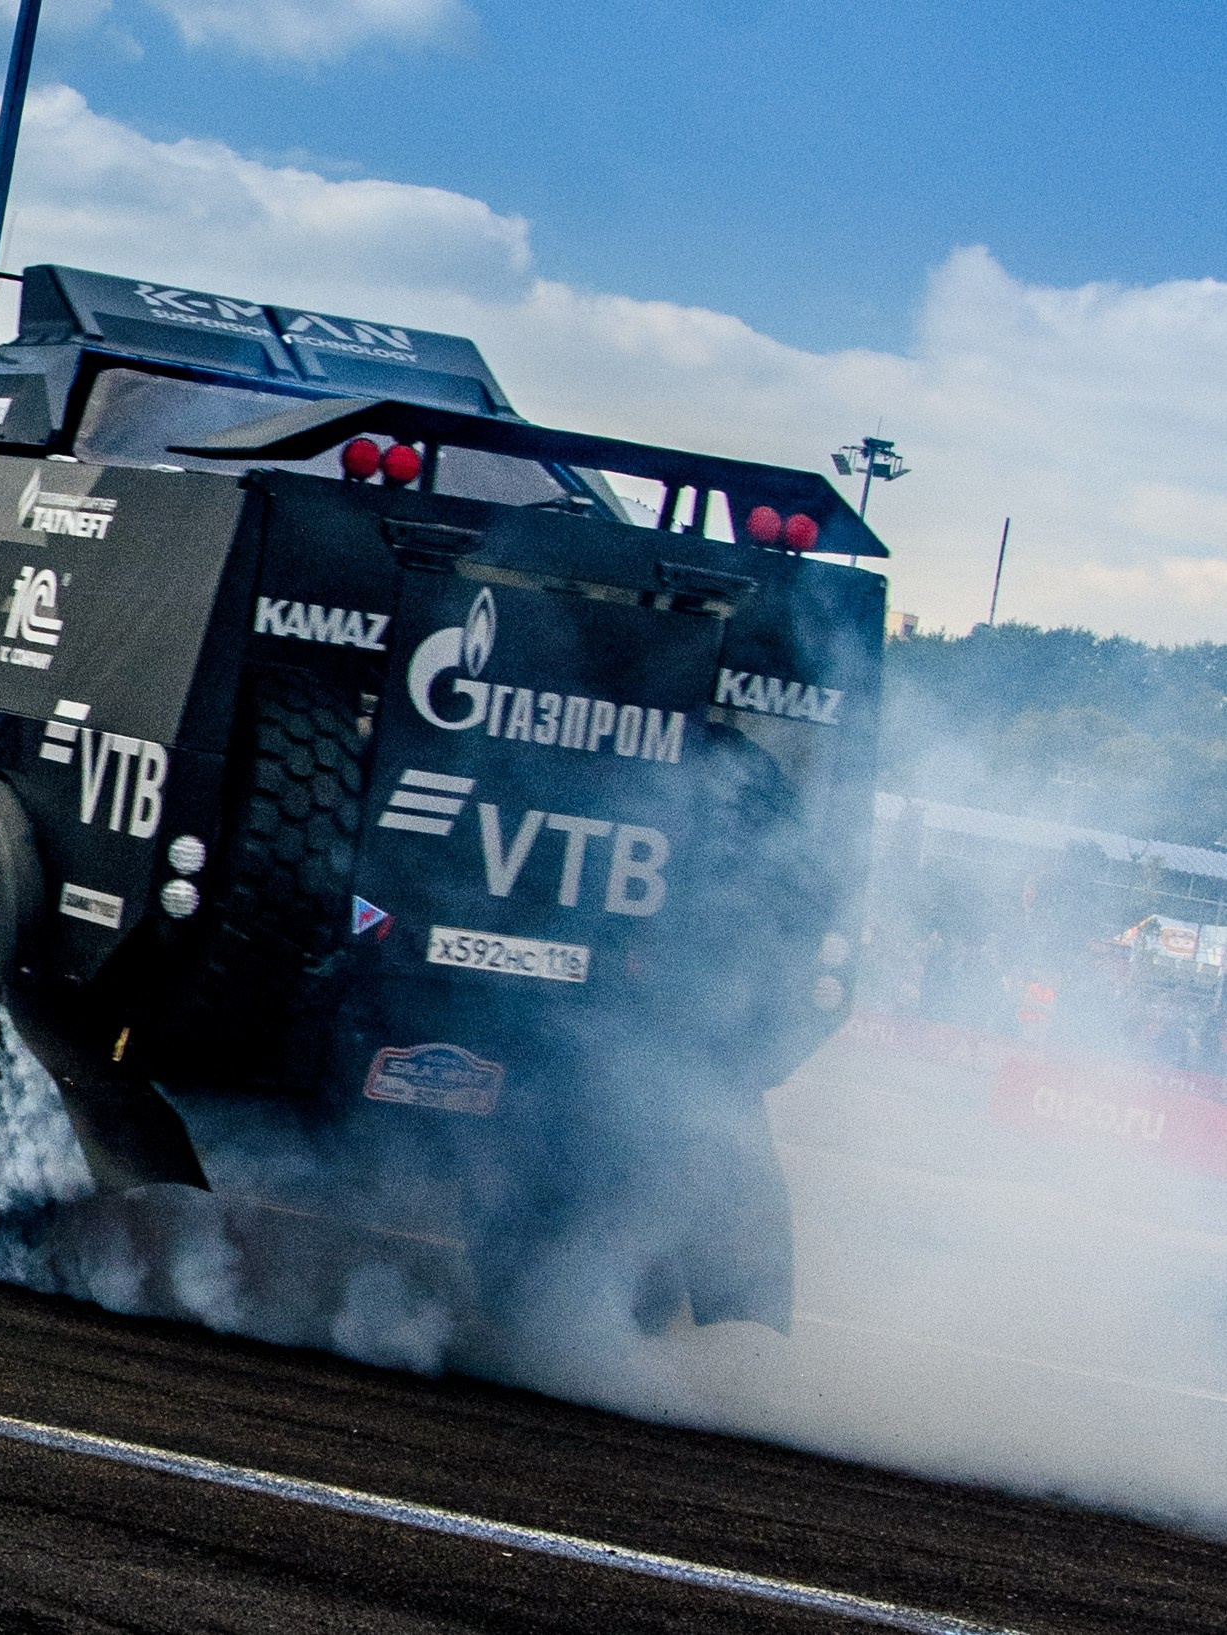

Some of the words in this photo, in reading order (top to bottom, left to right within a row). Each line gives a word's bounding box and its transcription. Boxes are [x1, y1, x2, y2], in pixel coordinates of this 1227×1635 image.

[151, 308, 274, 338] SUSPENSION
[282, 333, 418, 363] TECHNOLOGY
[31, 506, 114, 540] TATNEFT
[253, 595, 391, 651] KAMAZ
[715, 667, 845, 725] KAMAZ
[78, 727, 170, 839] VTB
[477, 801, 674, 918] VTB
